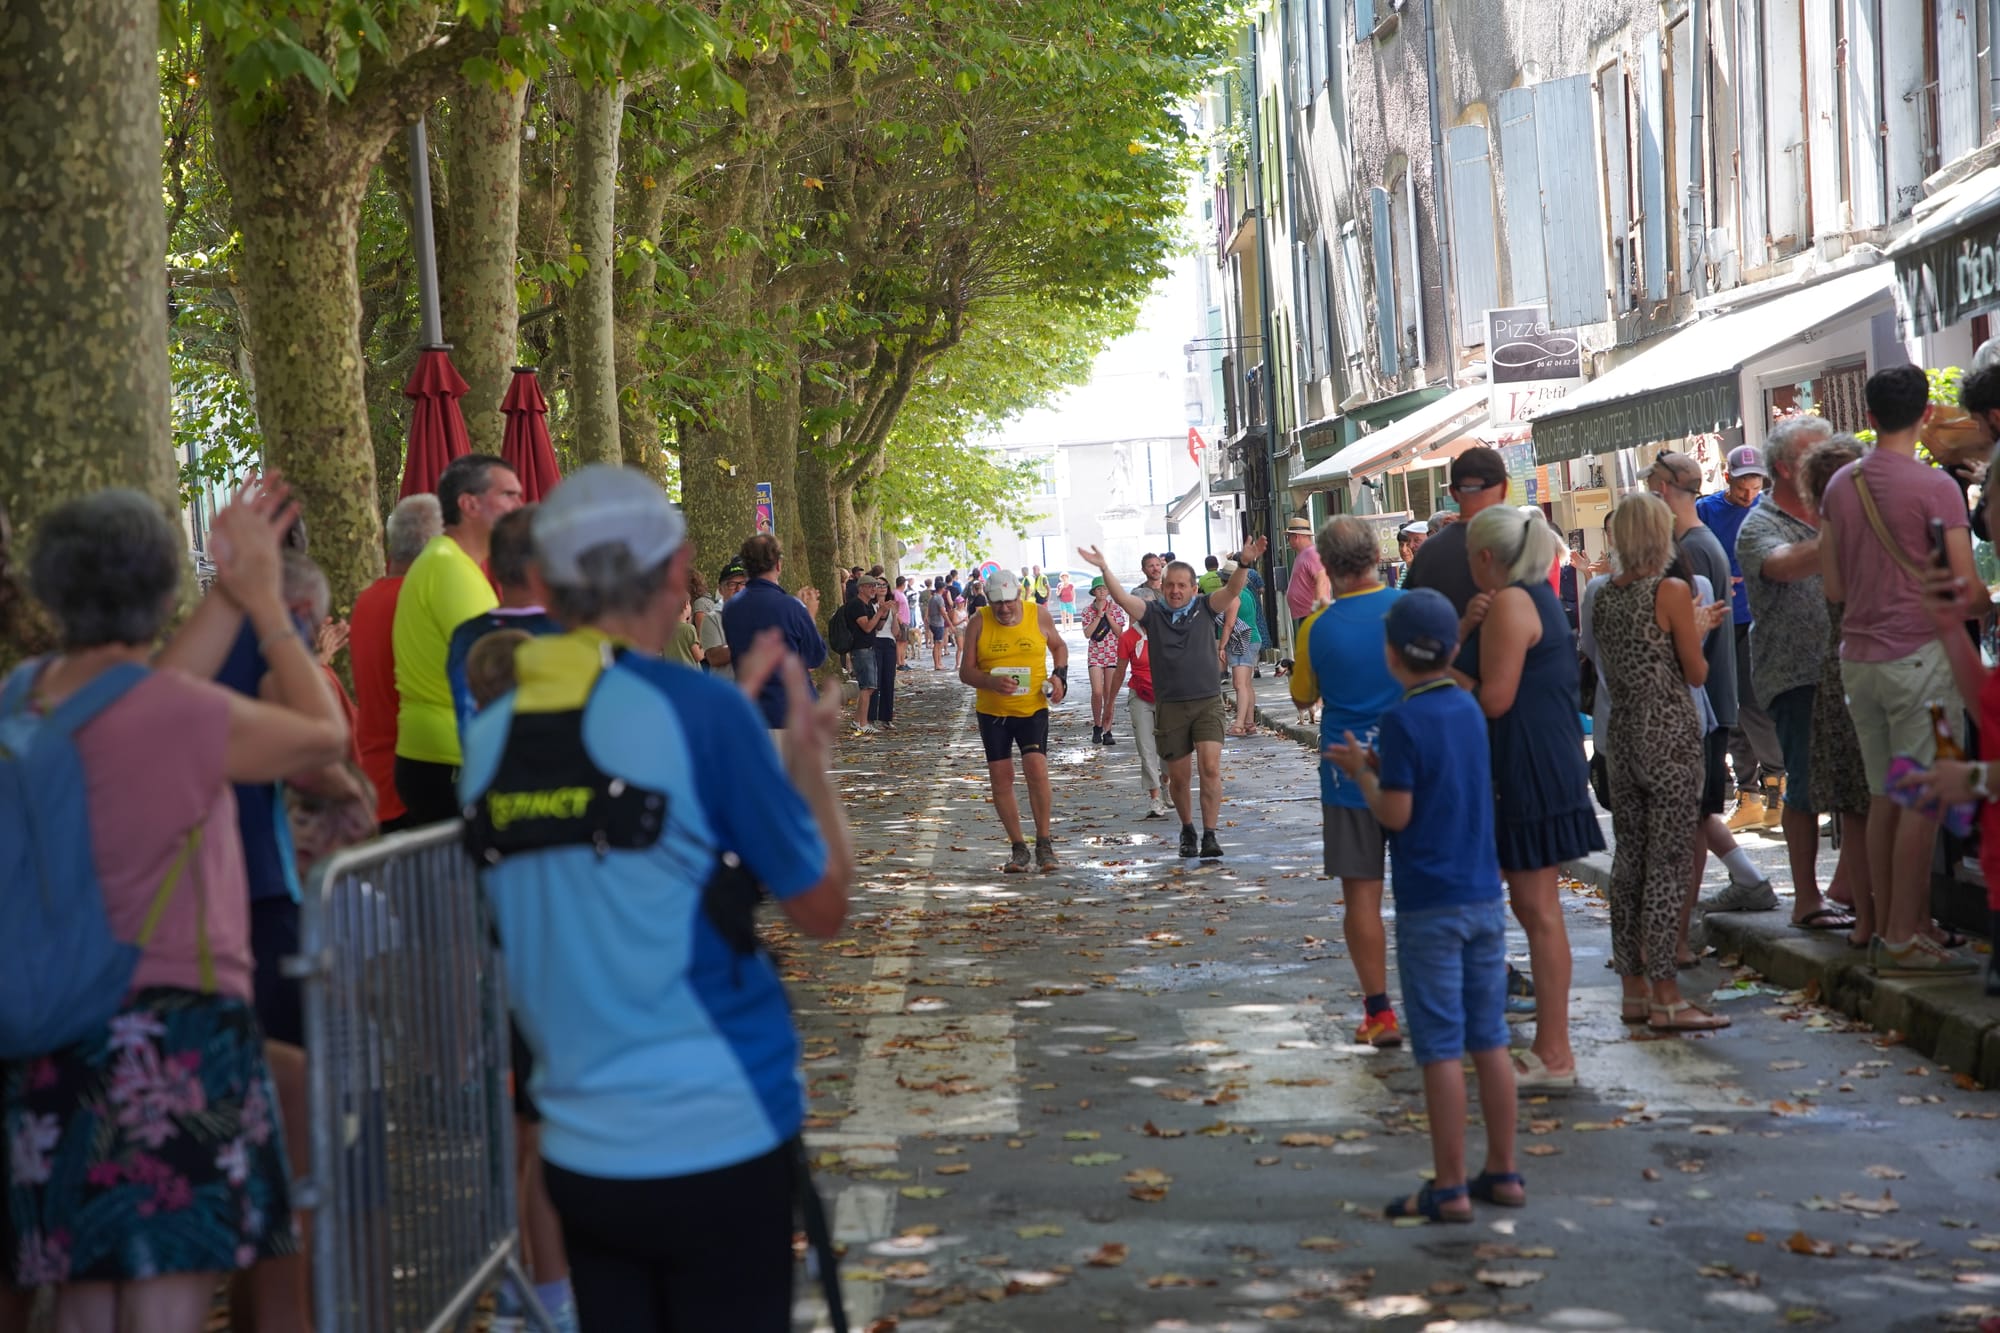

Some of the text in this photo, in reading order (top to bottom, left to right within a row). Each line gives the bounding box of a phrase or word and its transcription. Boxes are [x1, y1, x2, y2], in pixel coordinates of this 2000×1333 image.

[1538, 385, 1567, 400] Petit
[1580, 410, 1632, 451] CHARCUTERIE
[1636, 397, 1681, 438] MAISON
